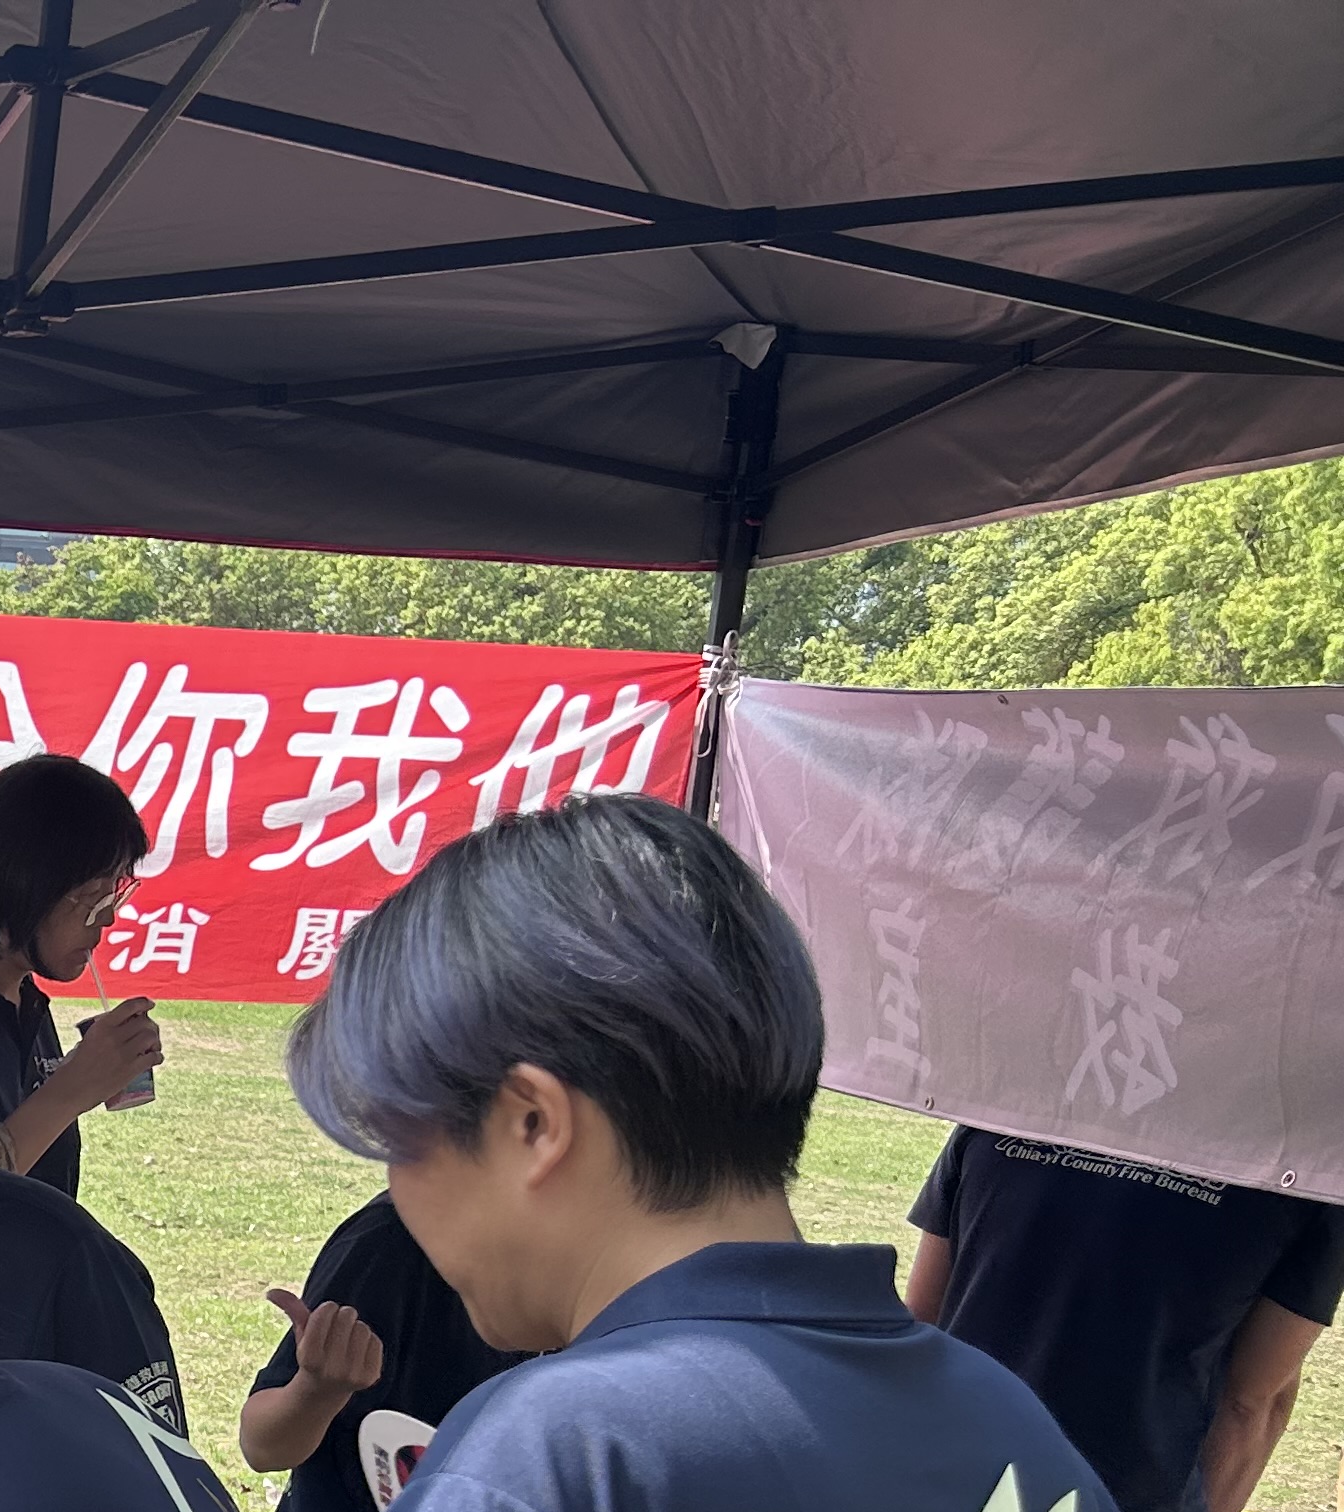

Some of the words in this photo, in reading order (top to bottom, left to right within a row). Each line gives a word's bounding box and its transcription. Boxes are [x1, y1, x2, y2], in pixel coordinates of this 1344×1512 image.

[1005, 1143, 1060, 1166] Chia-yi
[1061, 1155, 1118, 1179] County
[1118, 1166, 1153, 1185] Fire
[1155, 1174, 1223, 1206] Bureau
